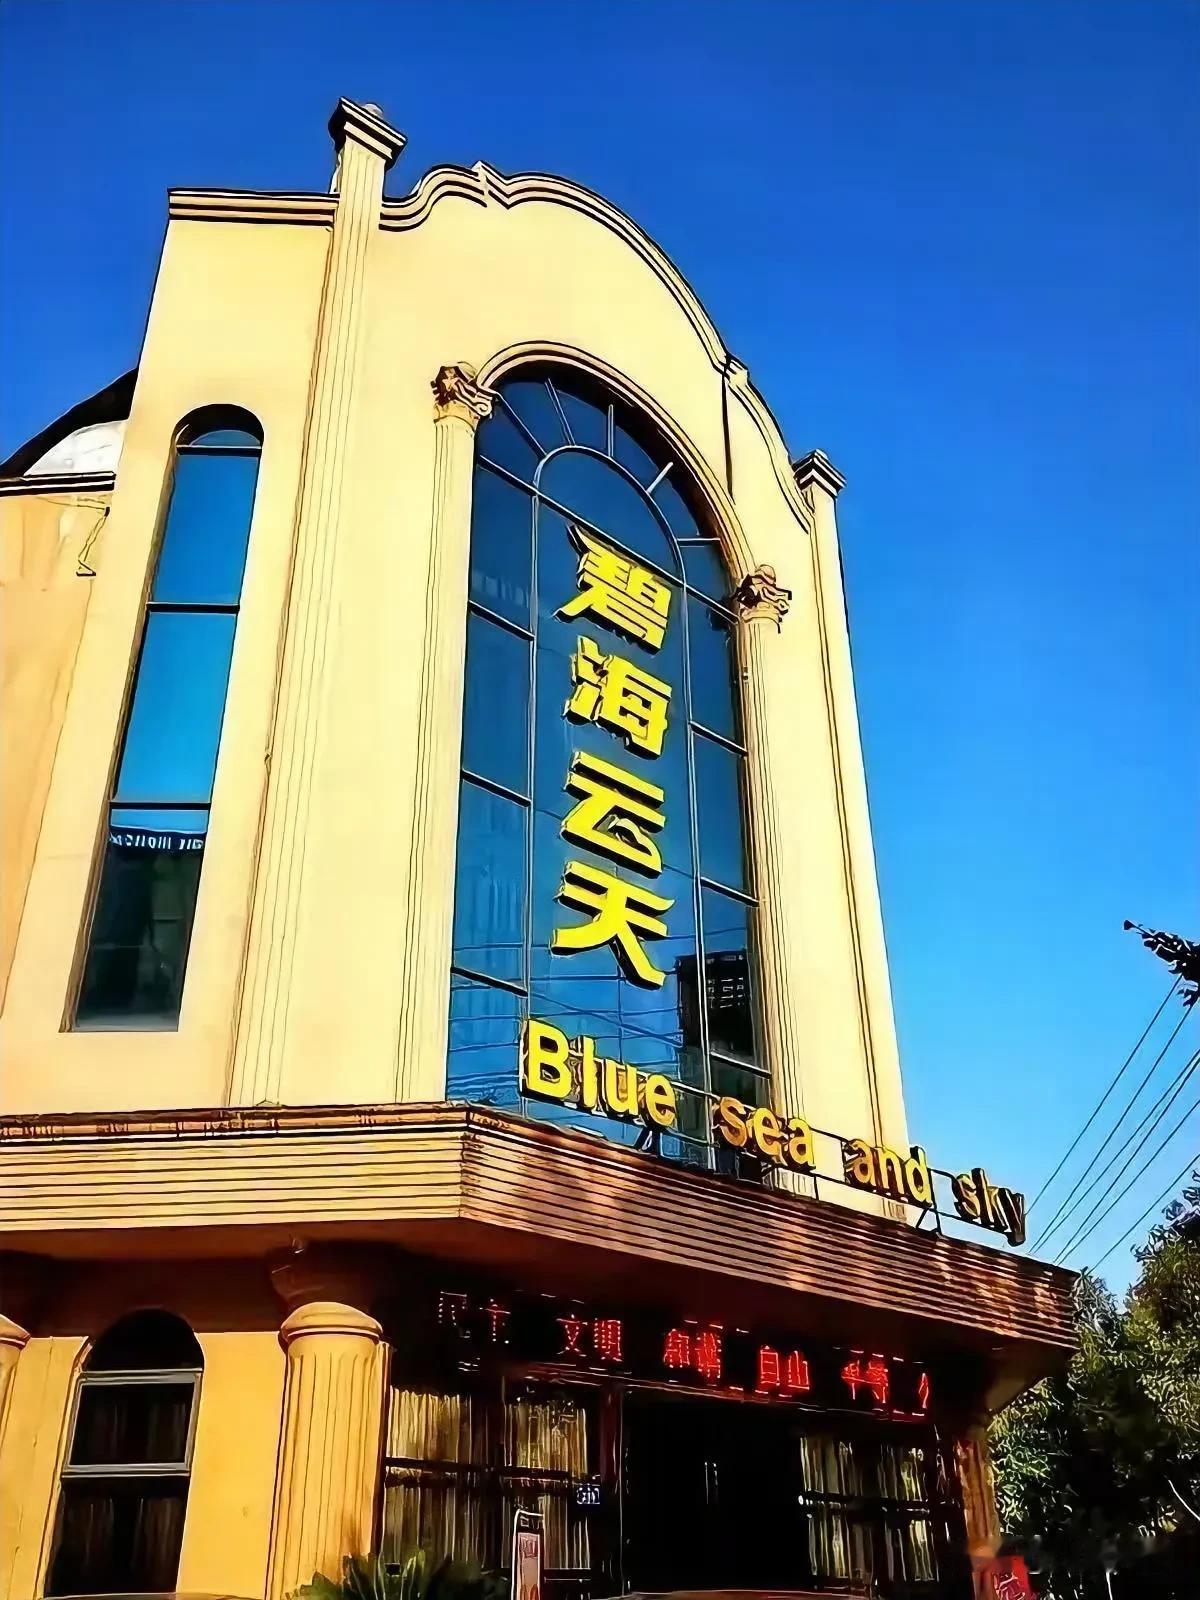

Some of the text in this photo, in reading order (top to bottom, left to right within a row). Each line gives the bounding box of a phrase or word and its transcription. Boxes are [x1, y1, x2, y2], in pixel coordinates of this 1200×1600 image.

[551, 524, 675, 990] 碧海云天
[521, 1017, 1027, 1247] Blue sea and sky
